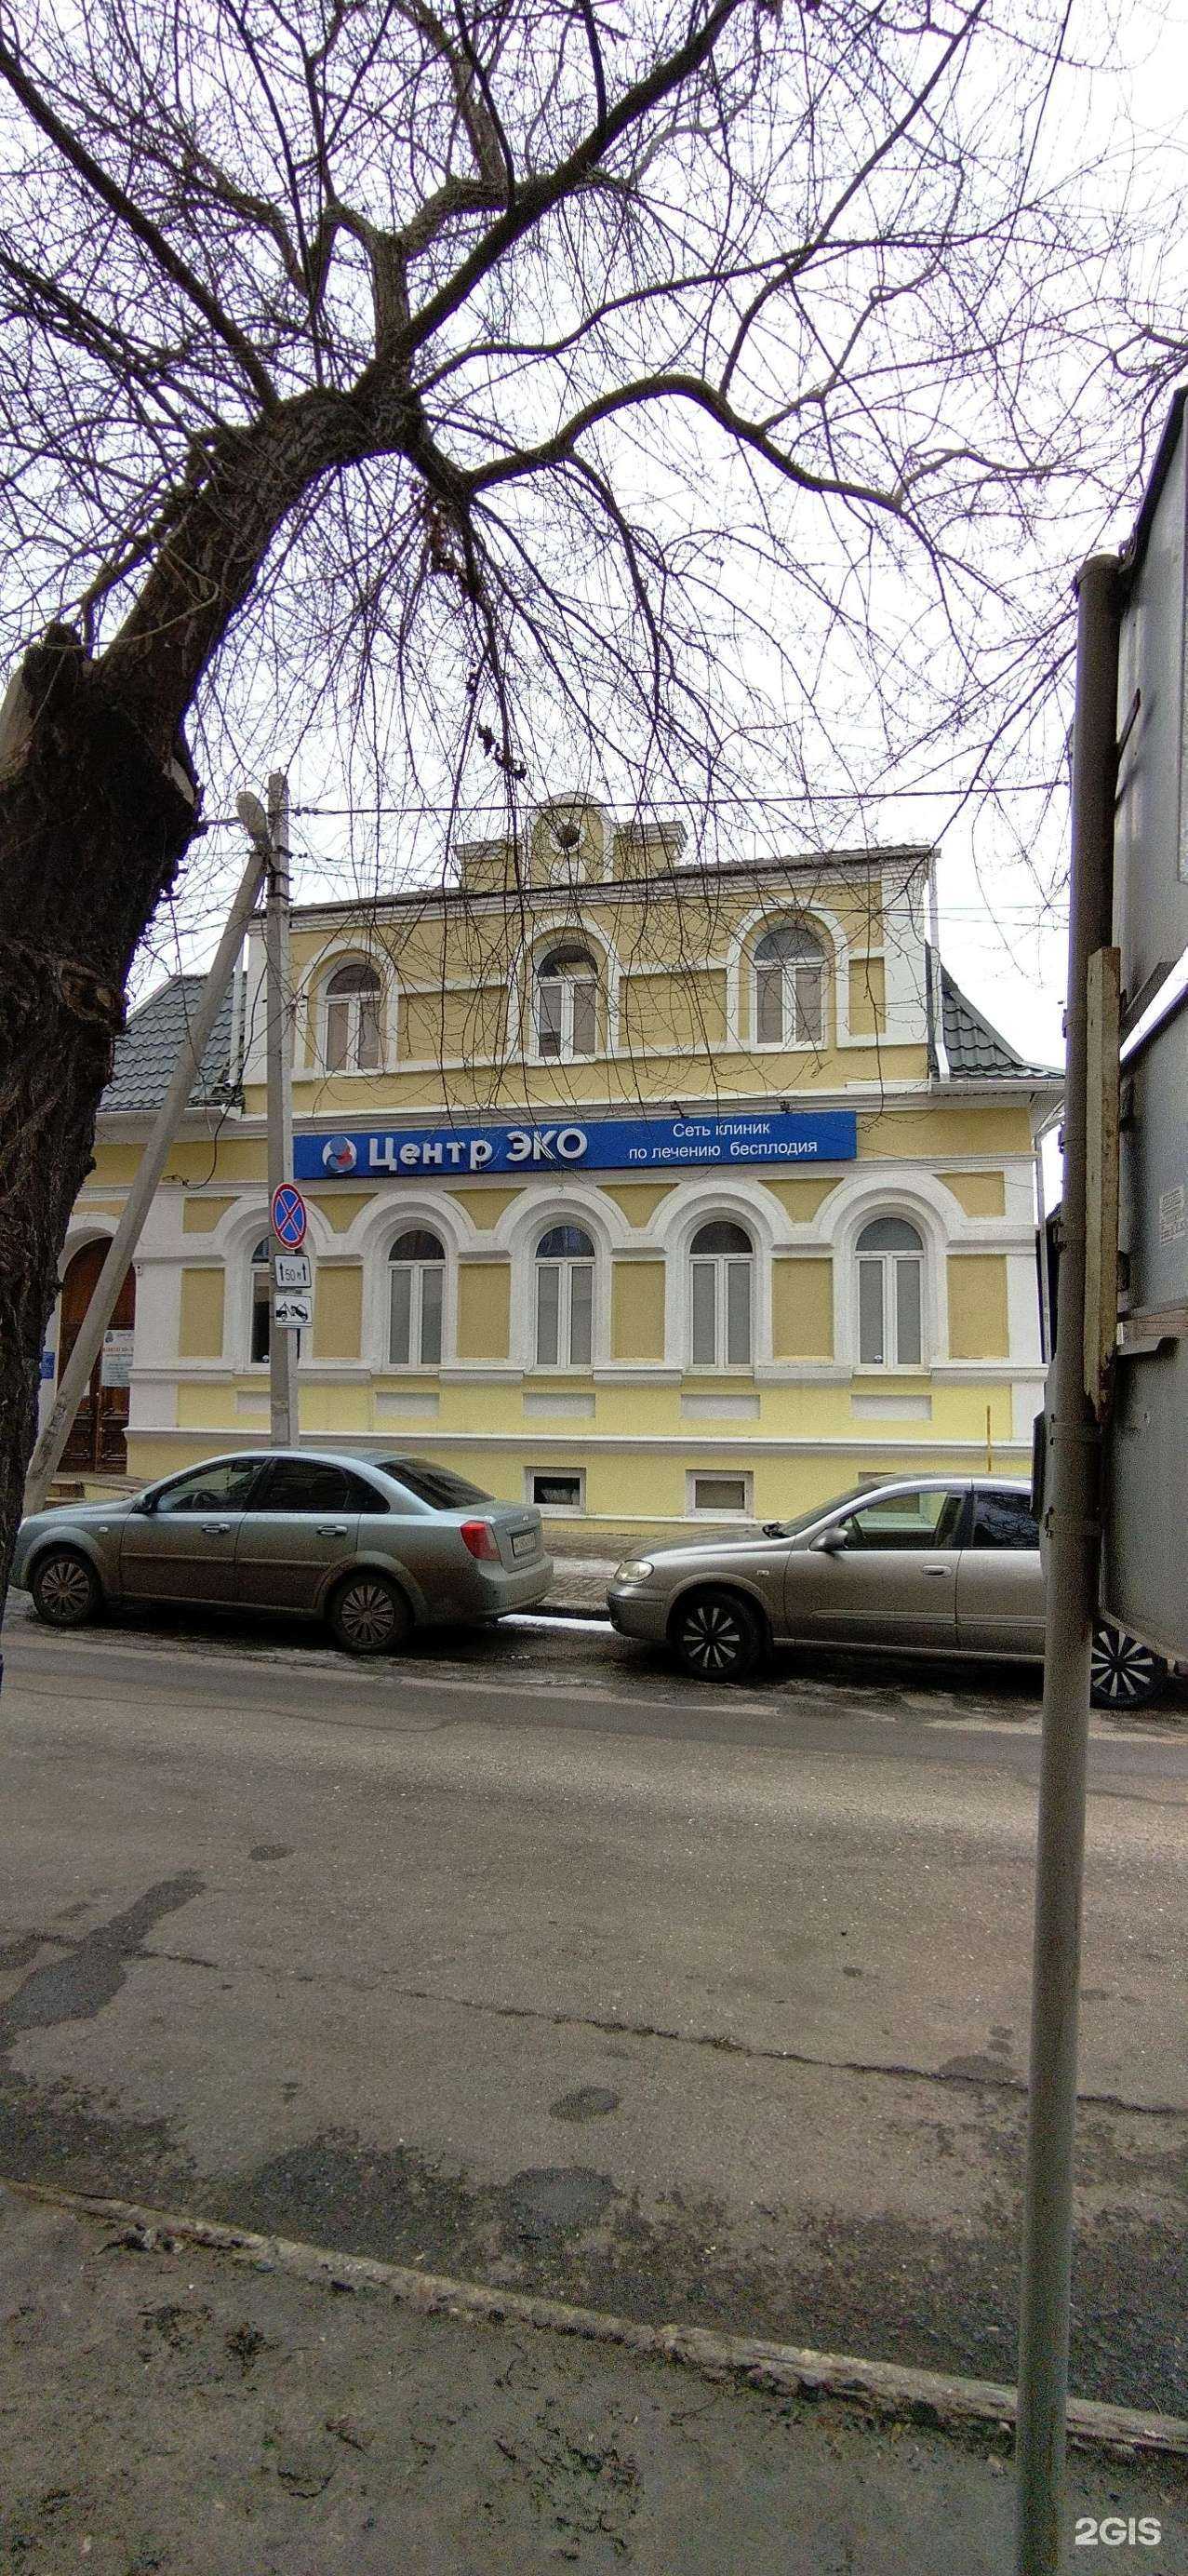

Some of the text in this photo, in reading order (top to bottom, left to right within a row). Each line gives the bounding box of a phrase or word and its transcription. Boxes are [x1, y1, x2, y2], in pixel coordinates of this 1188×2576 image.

[673, 1122, 770, 1137] Сеть клиник
[368, 1127, 588, 1171] Центр ЭКО
[629, 1141, 818, 1160] по лечению бесплодия
[285, 1268, 296, 1281] 50
